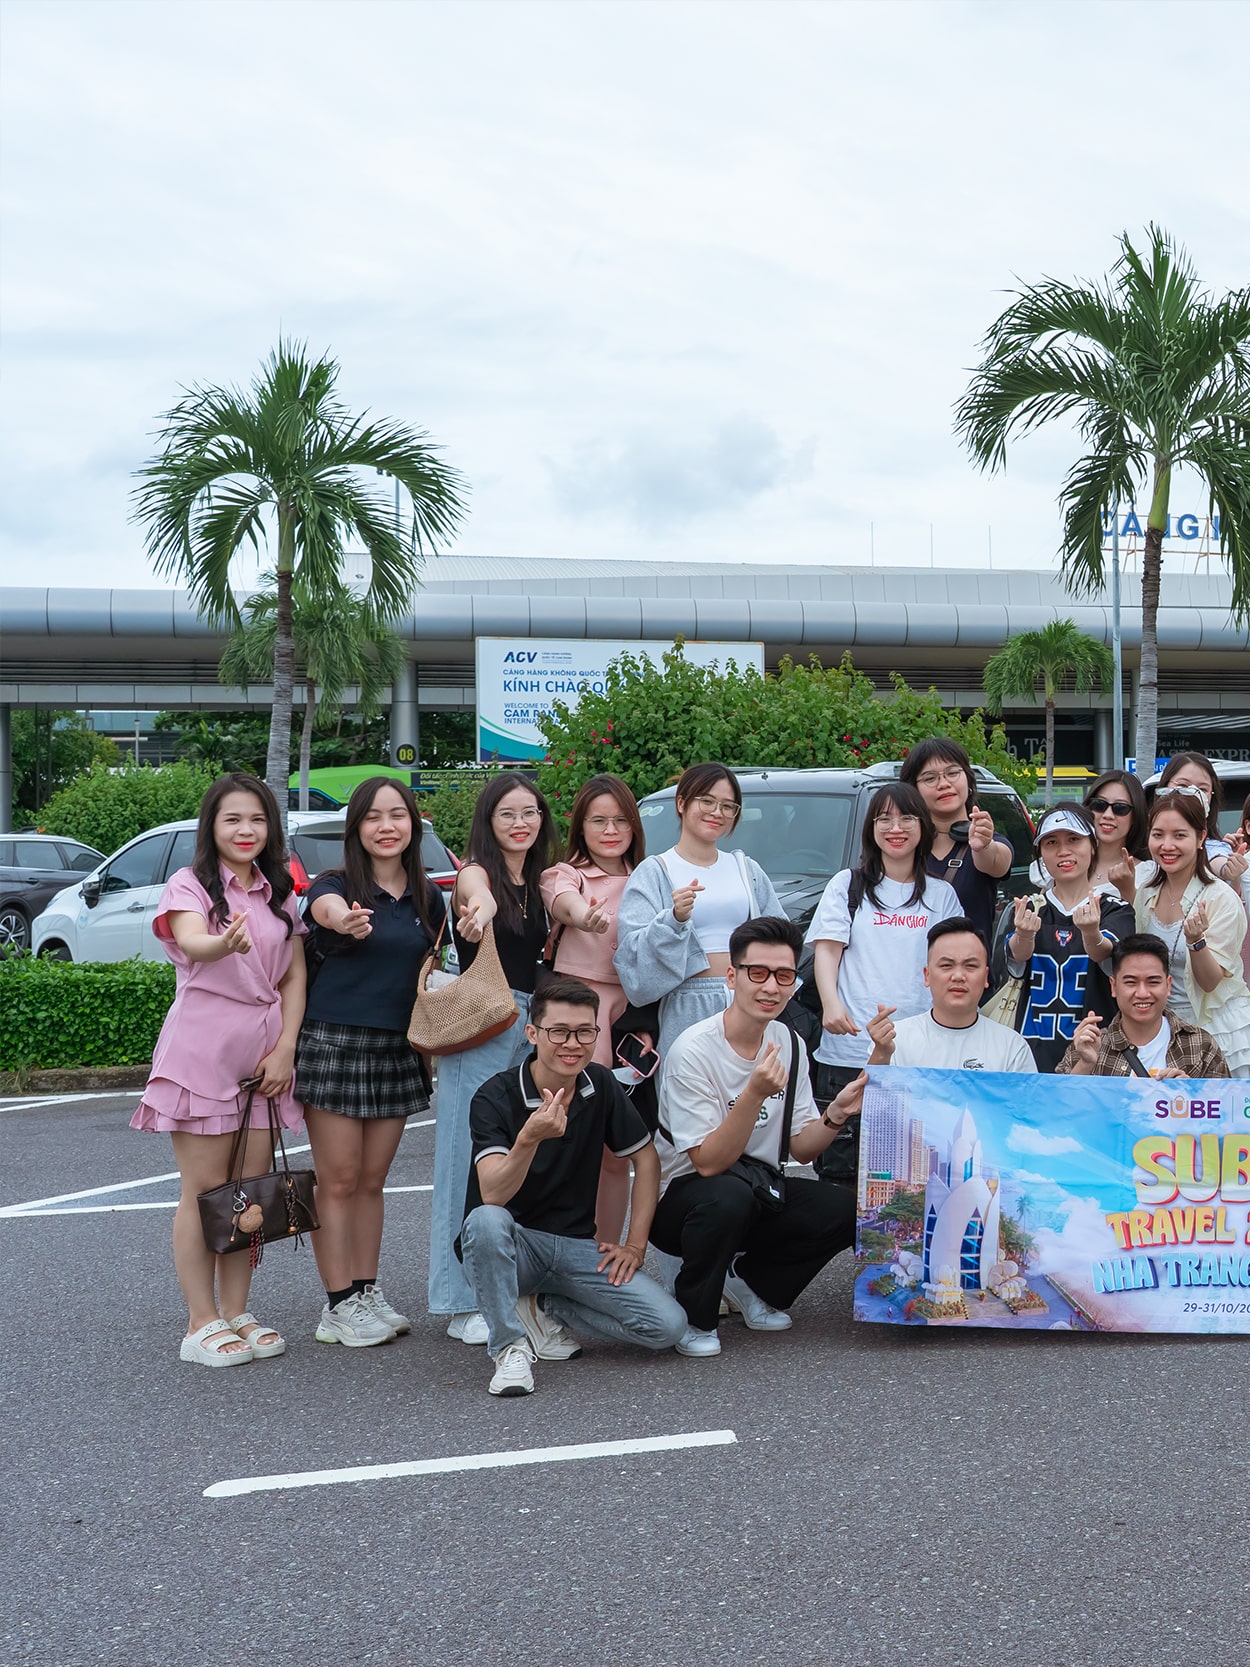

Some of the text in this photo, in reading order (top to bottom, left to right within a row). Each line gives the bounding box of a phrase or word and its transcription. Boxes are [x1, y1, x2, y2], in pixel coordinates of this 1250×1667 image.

[504, 651, 537, 663] ACV
[550, 667, 577, 677] KHÔNG
[503, 677, 540, 693] KÍNH
[545, 678, 587, 694] CHÀO
[504, 709, 530, 718] CAM
[399, 749, 414, 761] 08
[1155, 1096, 1221, 1119] SUBE
[1105, 1206, 1236, 1250] TRAVEL
[1091, 1255, 1159, 1294] NHA
